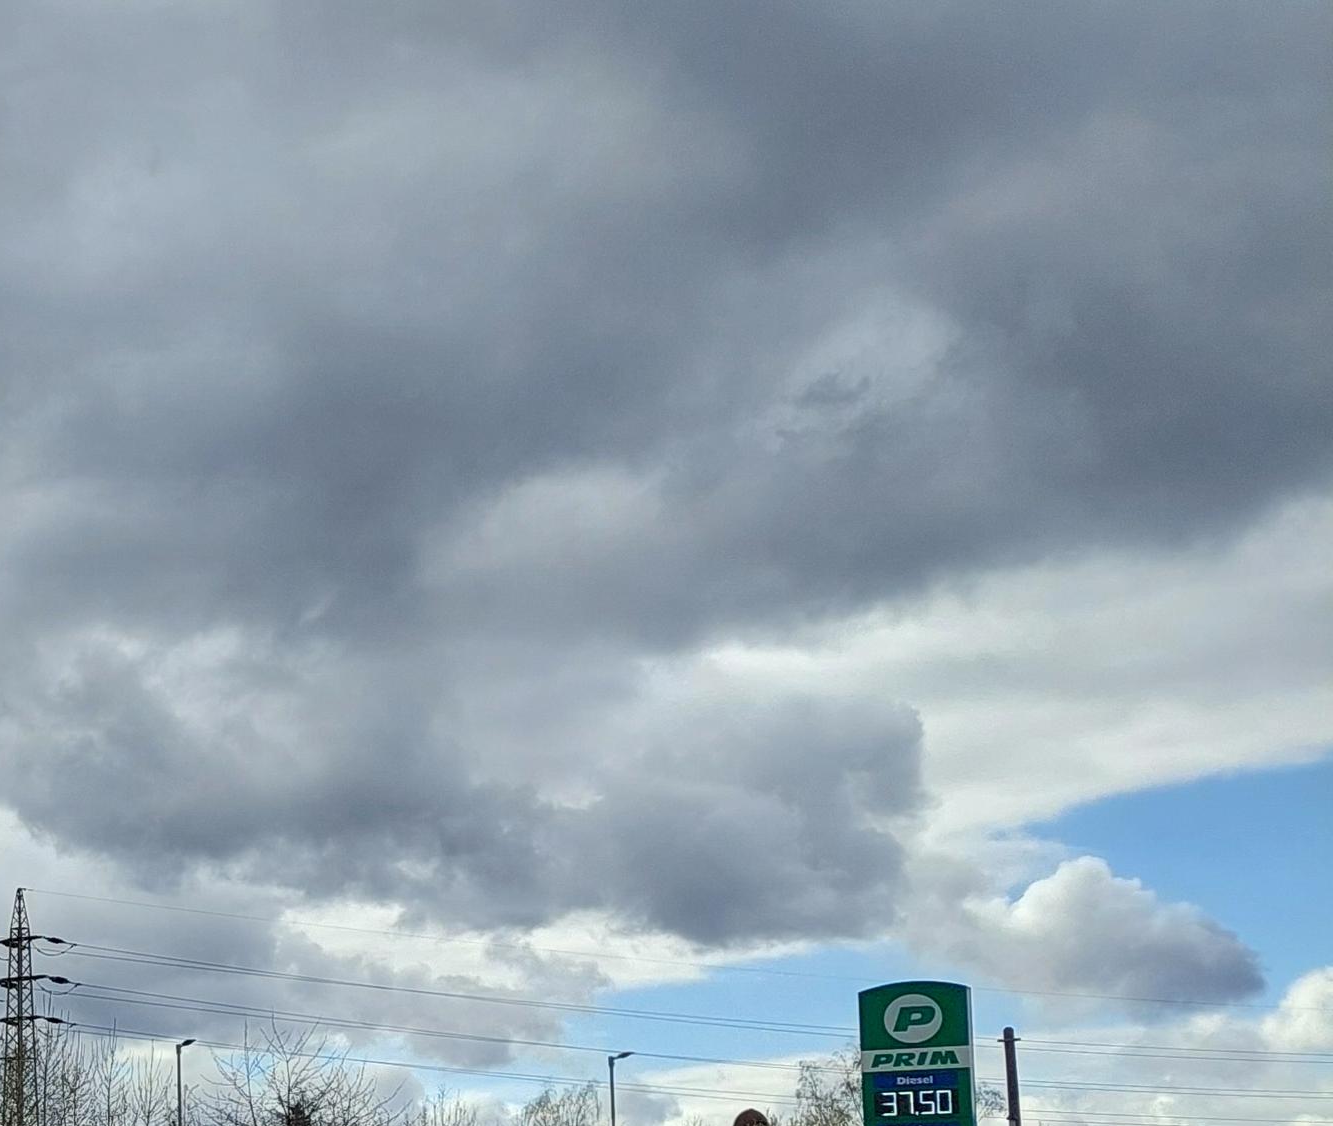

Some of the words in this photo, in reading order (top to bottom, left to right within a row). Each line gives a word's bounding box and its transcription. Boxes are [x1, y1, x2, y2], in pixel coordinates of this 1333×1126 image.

[893, 1005, 936, 1032] P
[871, 1050, 959, 1068] PRIM
[896, 1075, 933, 1085] Diesel
[881, 1089, 952, 1116] 37.50
